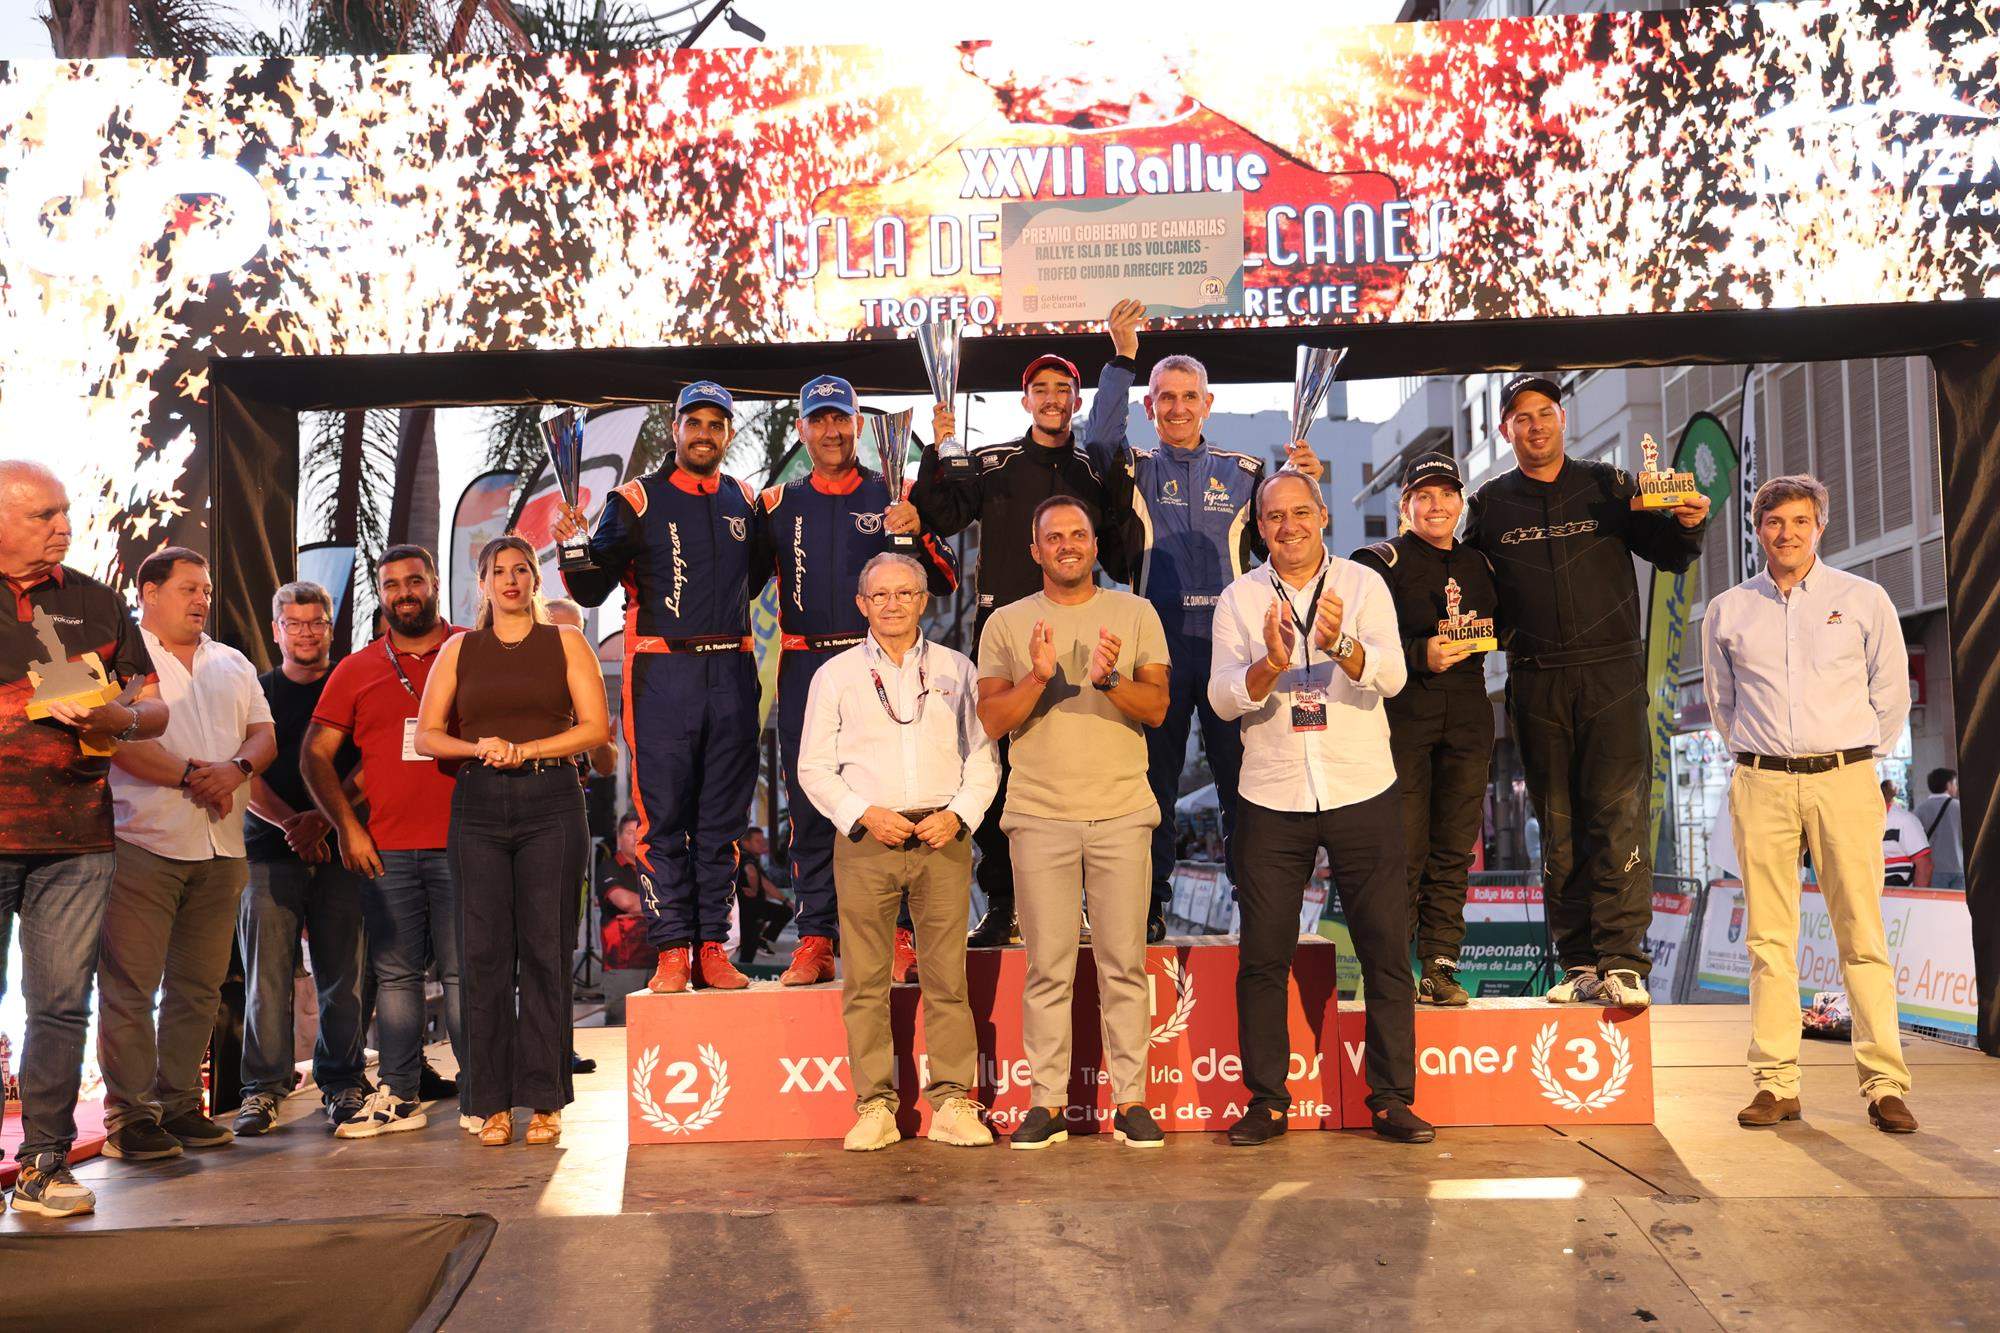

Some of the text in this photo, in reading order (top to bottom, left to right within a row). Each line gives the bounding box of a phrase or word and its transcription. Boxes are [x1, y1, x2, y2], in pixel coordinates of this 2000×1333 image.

[958, 142, 1269, 198] XXVII Rallye
[774, 200, 1452, 280] ISLA DE CANES
[1022, 218, 1226, 244] PREMIO GOBIERNO DE CANARIAS
[1035, 245, 1074, 260] RALLYE
[1078, 243, 1101, 258] ISLA
[1104, 243, 1118, 257] DE
[1121, 242, 1142, 256] LOS
[1145, 239, 1201, 255] VOLCANES
[1038, 260, 1208, 281] TROFEO CIUDAD ARRECIFE 2025
[1205, 283, 1219, 294] FCA
[1243, 285, 1358, 317] RECIFE
[1052, 301, 1086, 309] Canarias
[1641, 480, 1694, 494] VOLCANES
[665, 521, 688, 618] Lanzagrava
[793, 516, 806, 611] Lanzagrava
[1460, 943, 1541, 960] mpeonato
[1490, 961, 1501, 971] de
[1504, 960, 1523, 971] Las
[1151, 1065, 1183, 1084] Isla
[1191, 1048, 1243, 1082] de
[1286, 1052, 1324, 1081] os
[1564, 1037, 1600, 1082] 3
[665, 1061, 699, 1104] 2
[1175, 1102, 1213, 1120] de
